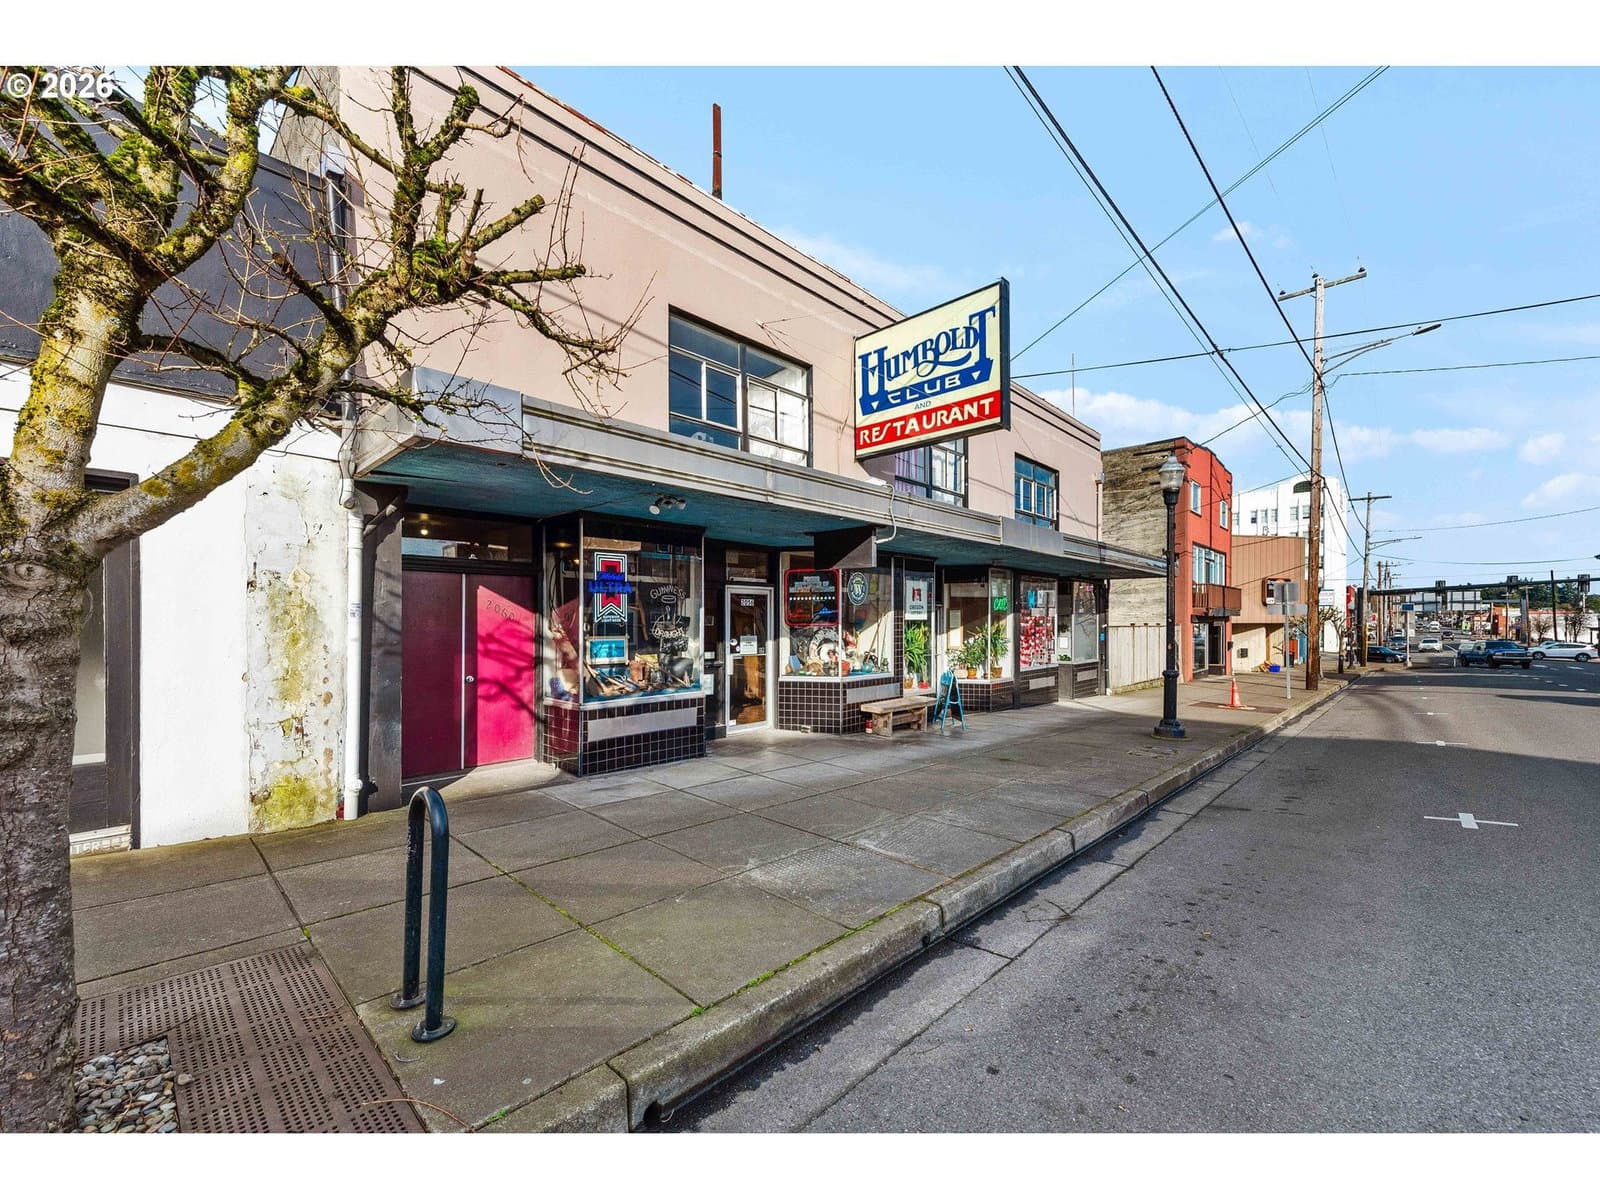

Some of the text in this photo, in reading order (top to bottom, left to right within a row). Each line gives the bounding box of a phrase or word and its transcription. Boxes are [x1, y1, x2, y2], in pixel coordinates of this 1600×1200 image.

[858, 306, 996, 397] HUMBOLDT
[887, 374, 961, 404] CLUB
[914, 400, 932, 411] AND
[860, 397, 994, 446] RESTAURANT
[588, 581, 632, 593] ULTRA
[649, 585, 687, 600] GUINNESS
